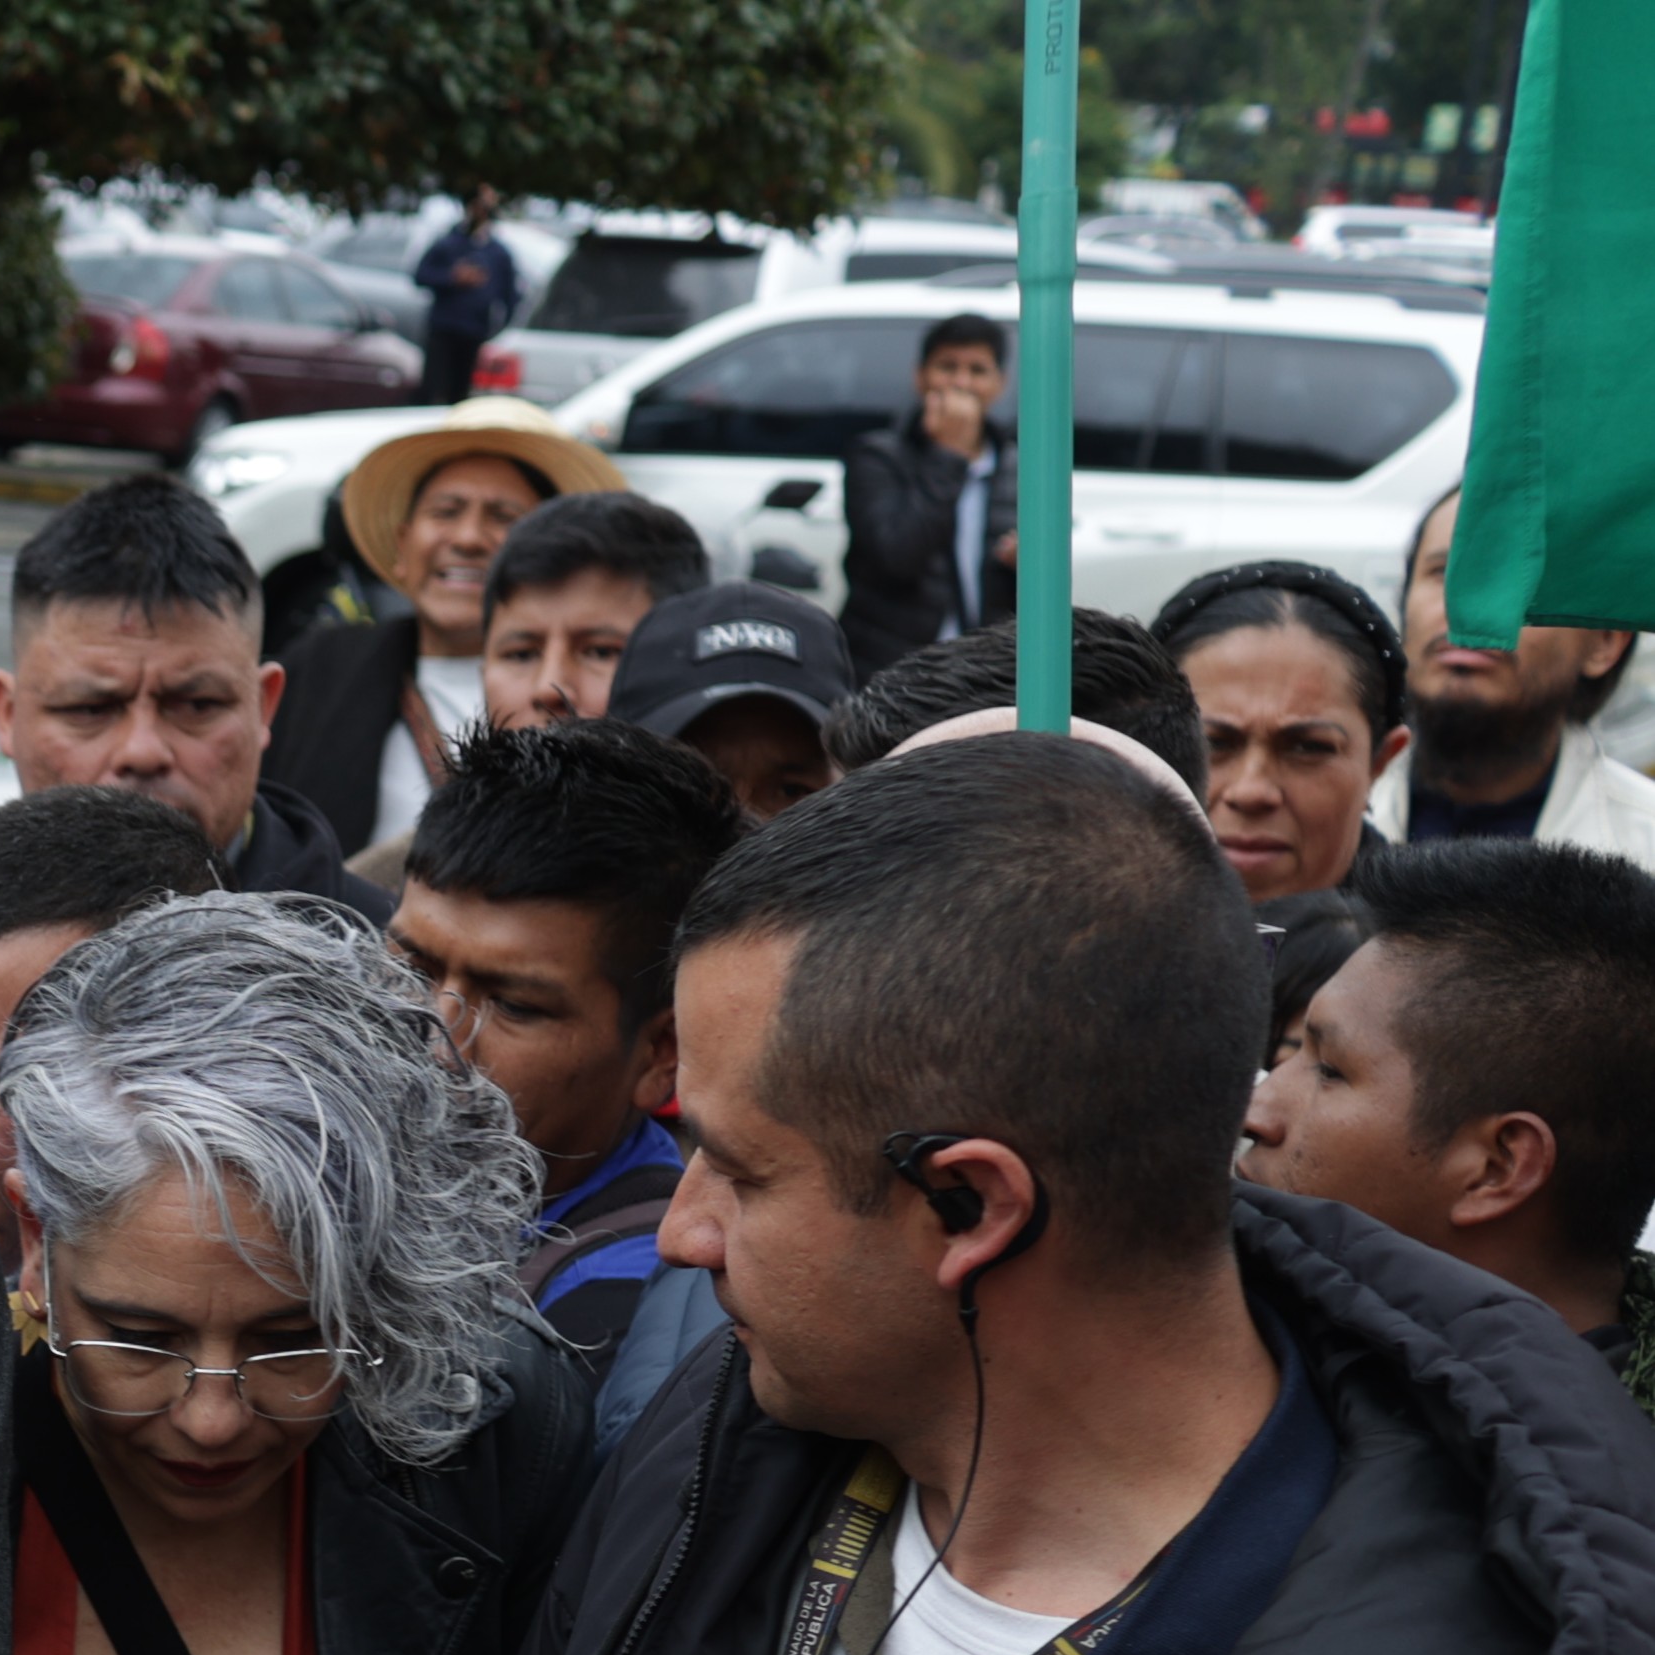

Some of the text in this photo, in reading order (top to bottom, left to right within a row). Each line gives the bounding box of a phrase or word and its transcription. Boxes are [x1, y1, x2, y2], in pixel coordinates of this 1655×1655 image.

[1044, 0, 1064, 76] PROT
[800, 1600, 813, 1619] DE
[807, 1581, 821, 1598] LA
